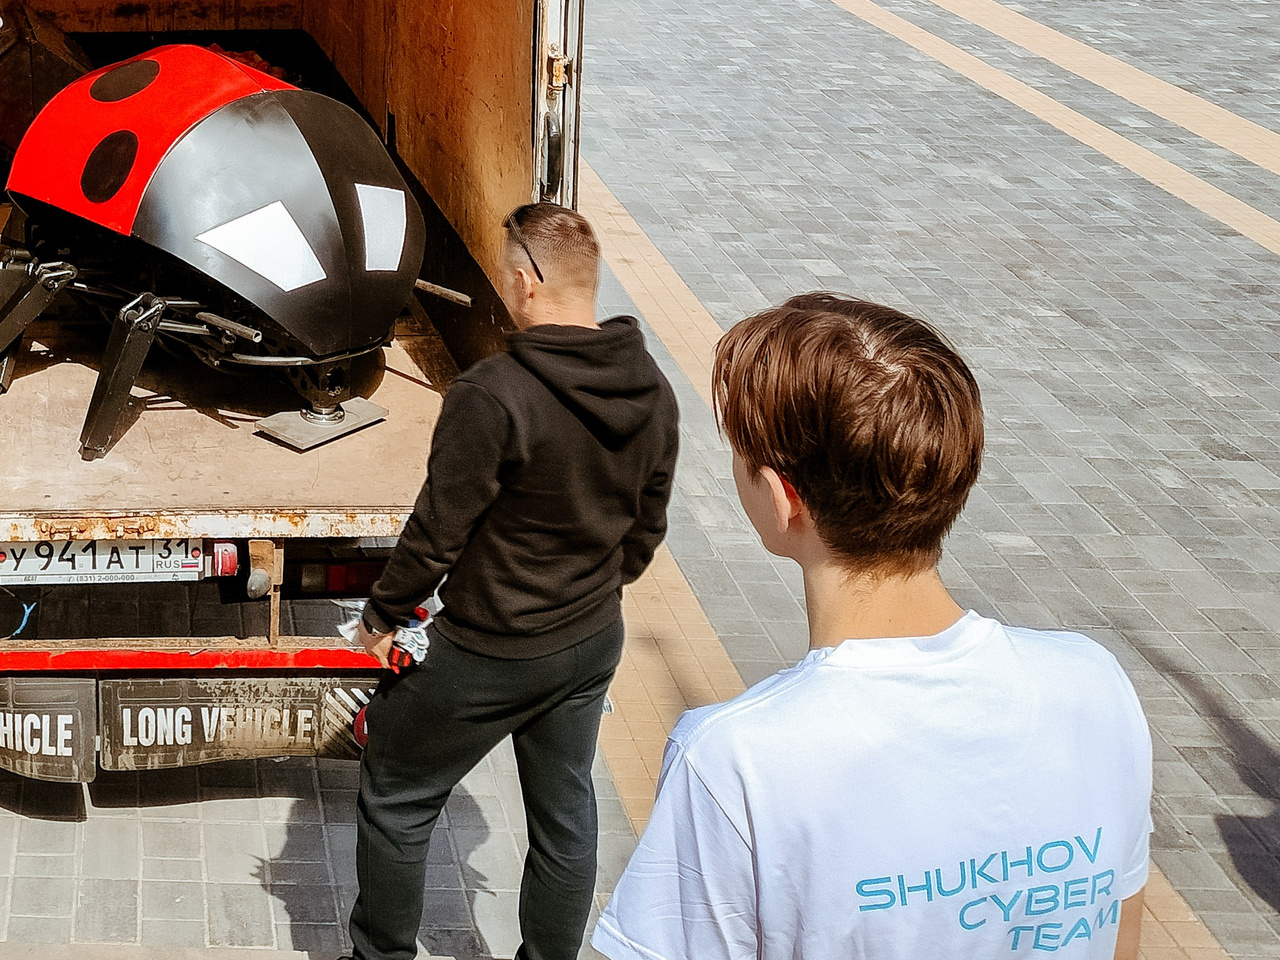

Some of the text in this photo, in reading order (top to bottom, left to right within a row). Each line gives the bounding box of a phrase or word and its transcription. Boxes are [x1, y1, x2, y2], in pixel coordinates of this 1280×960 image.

[156, 560, 180, 569] RUS
[122, 707, 314, 747] LONG VEHICLE
[855, 826, 1103, 912] SHUKHOV
[959, 869, 1115, 931] CYBER
[1007, 899, 1119, 952] TEAM
